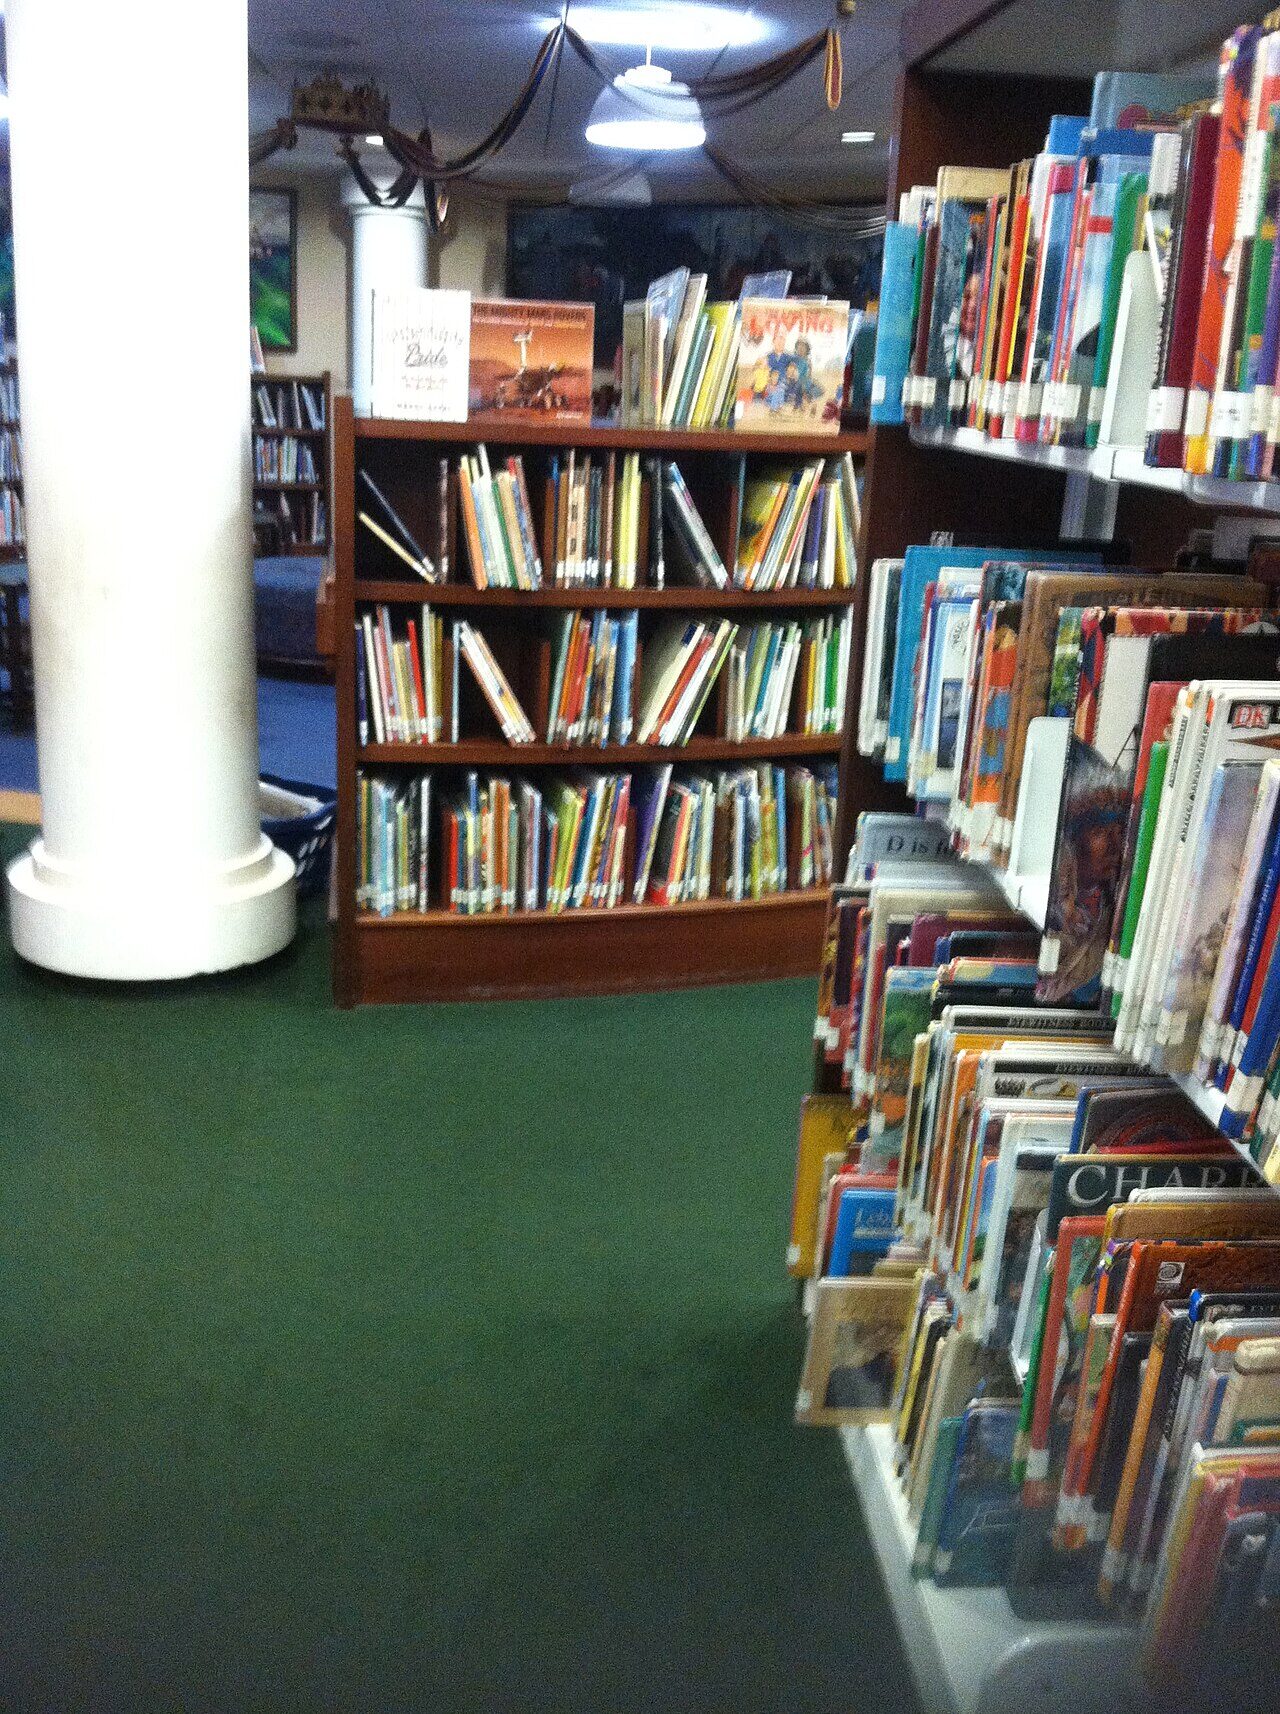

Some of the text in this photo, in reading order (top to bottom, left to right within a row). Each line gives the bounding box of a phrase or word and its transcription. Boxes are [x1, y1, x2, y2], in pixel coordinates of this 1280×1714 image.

[887, 835, 904, 854] D
[911, 837, 928, 854] is
[1008, 1017, 1076, 1029] EYEWITNESS
